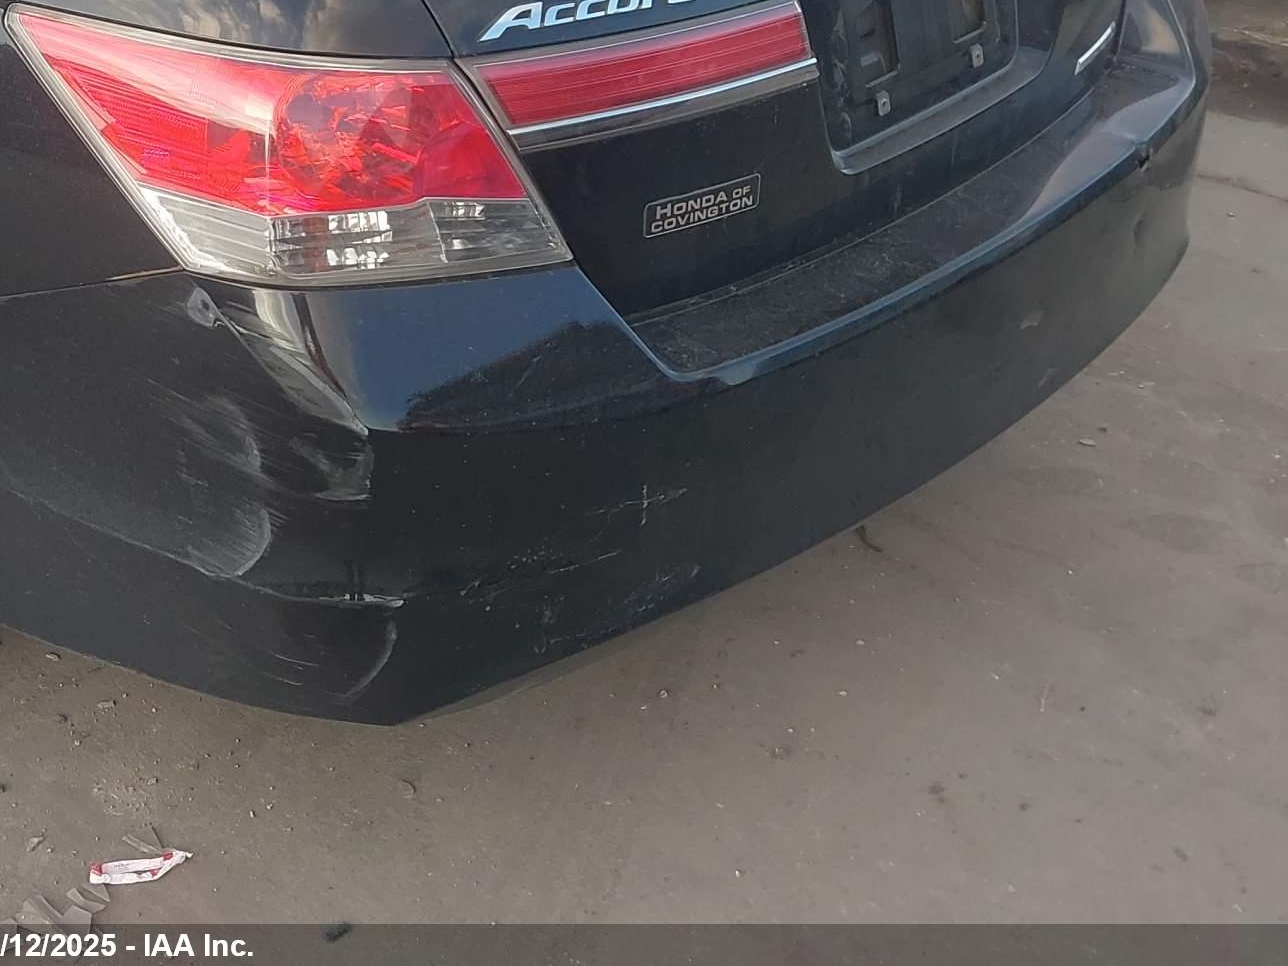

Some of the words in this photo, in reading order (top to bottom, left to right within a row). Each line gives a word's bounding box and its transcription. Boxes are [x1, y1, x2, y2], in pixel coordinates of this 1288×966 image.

[650, 195, 754, 233] COVINGTON
[655, 191, 728, 220] HONDA
[732, 185, 752, 199] OF
